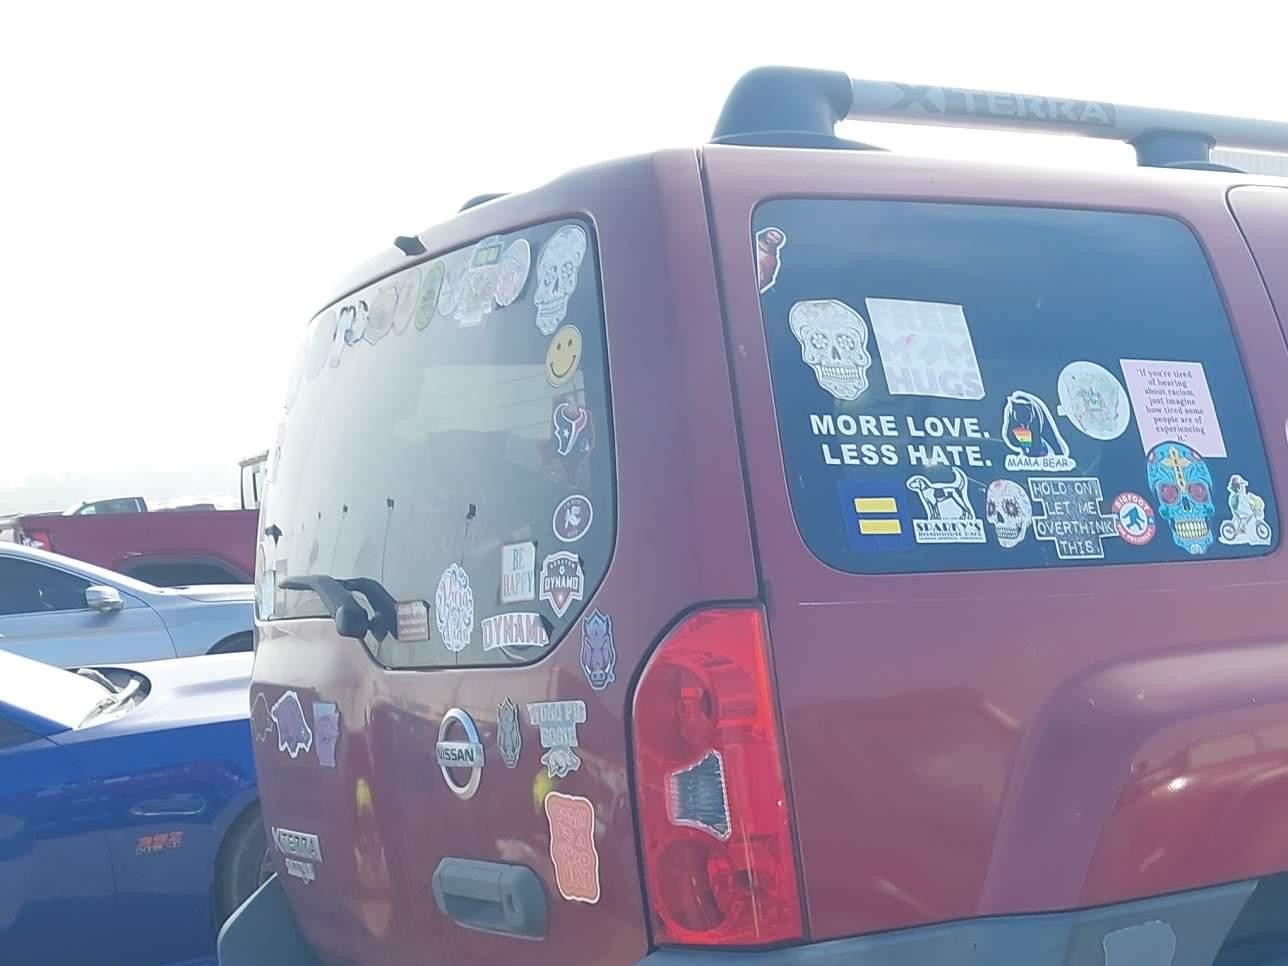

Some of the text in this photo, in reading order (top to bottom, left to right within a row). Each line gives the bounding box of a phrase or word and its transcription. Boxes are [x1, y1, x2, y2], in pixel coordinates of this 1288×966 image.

[1145, 387, 1166, 395] about
[1149, 397, 1195, 407] just imagine
[809, 414, 991, 438] MORE LOVE.
[1153, 416, 1178, 425] people
[1155, 425, 1206, 435] experiencing
[822, 444, 992, 466] LESS HATE.
[1007, 457, 1068, 468] MAMA BEAR
[1033, 482, 1067, 496] HOLD
[1045, 501, 1096, 515] LET ME
[1037, 521, 1113, 535] OVERTHINK
[512, 548, 525, 570] BE
[503, 570, 533, 597] HAPPY
[544, 576, 579, 591] DYNAMO
[437, 747, 474, 762] NISSAN
